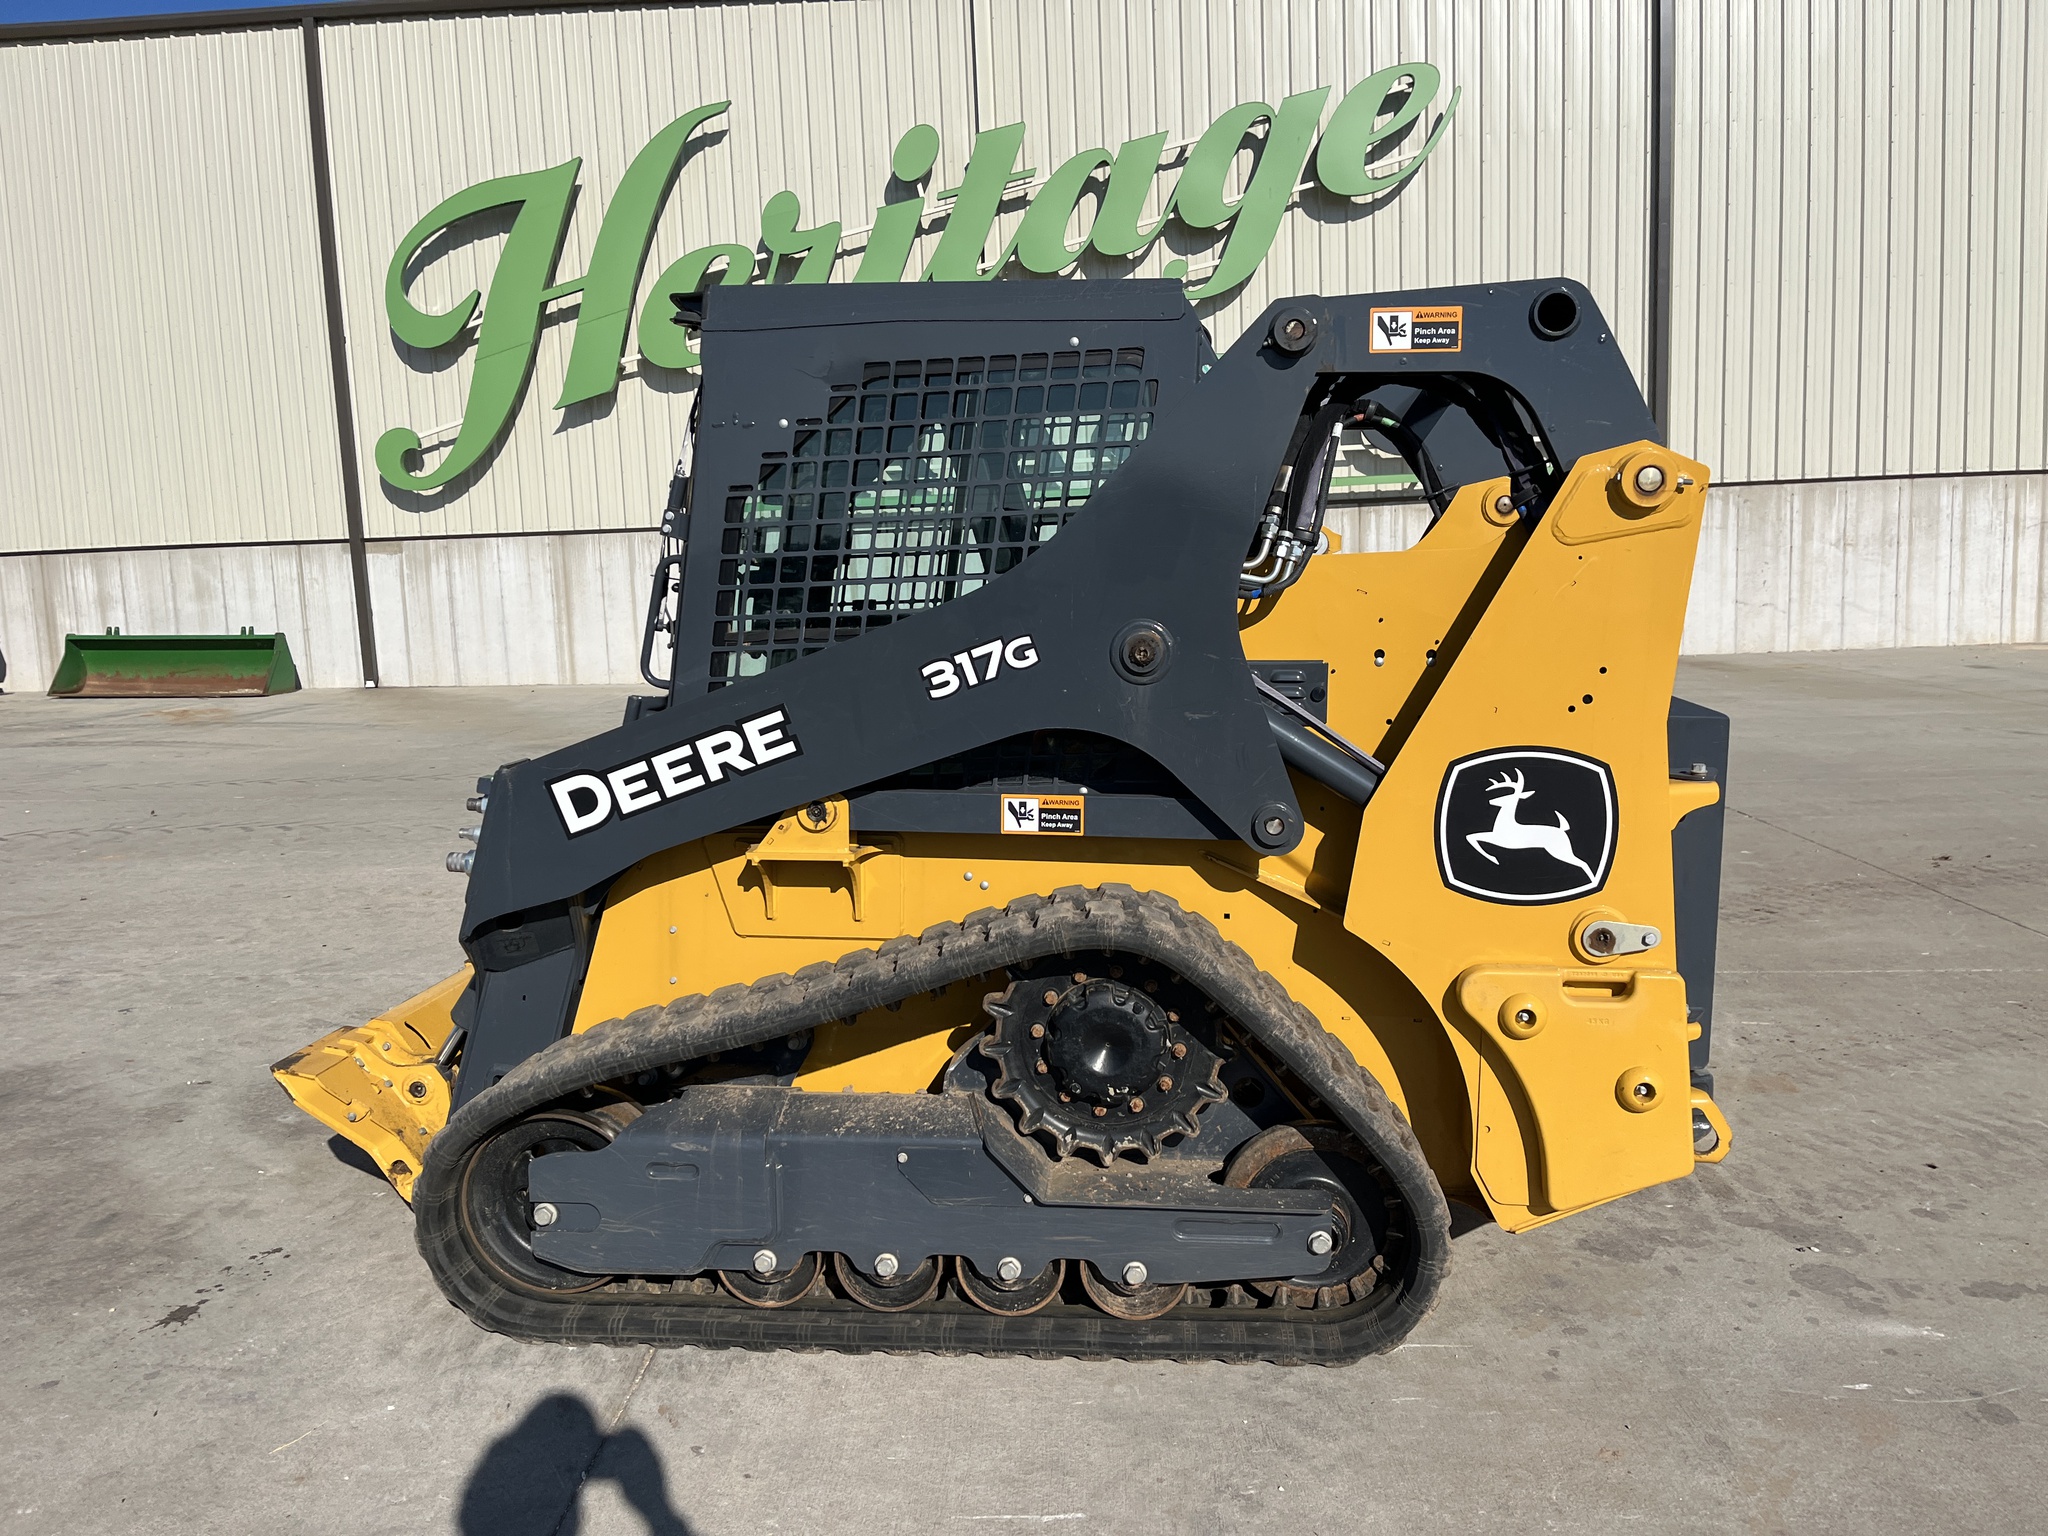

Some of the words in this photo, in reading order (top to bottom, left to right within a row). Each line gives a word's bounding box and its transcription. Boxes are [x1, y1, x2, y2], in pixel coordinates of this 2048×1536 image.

[375, 62, 1461, 492] Heritage
[922, 635, 1039, 699] 317G
[550, 710, 798, 834] DEERE
